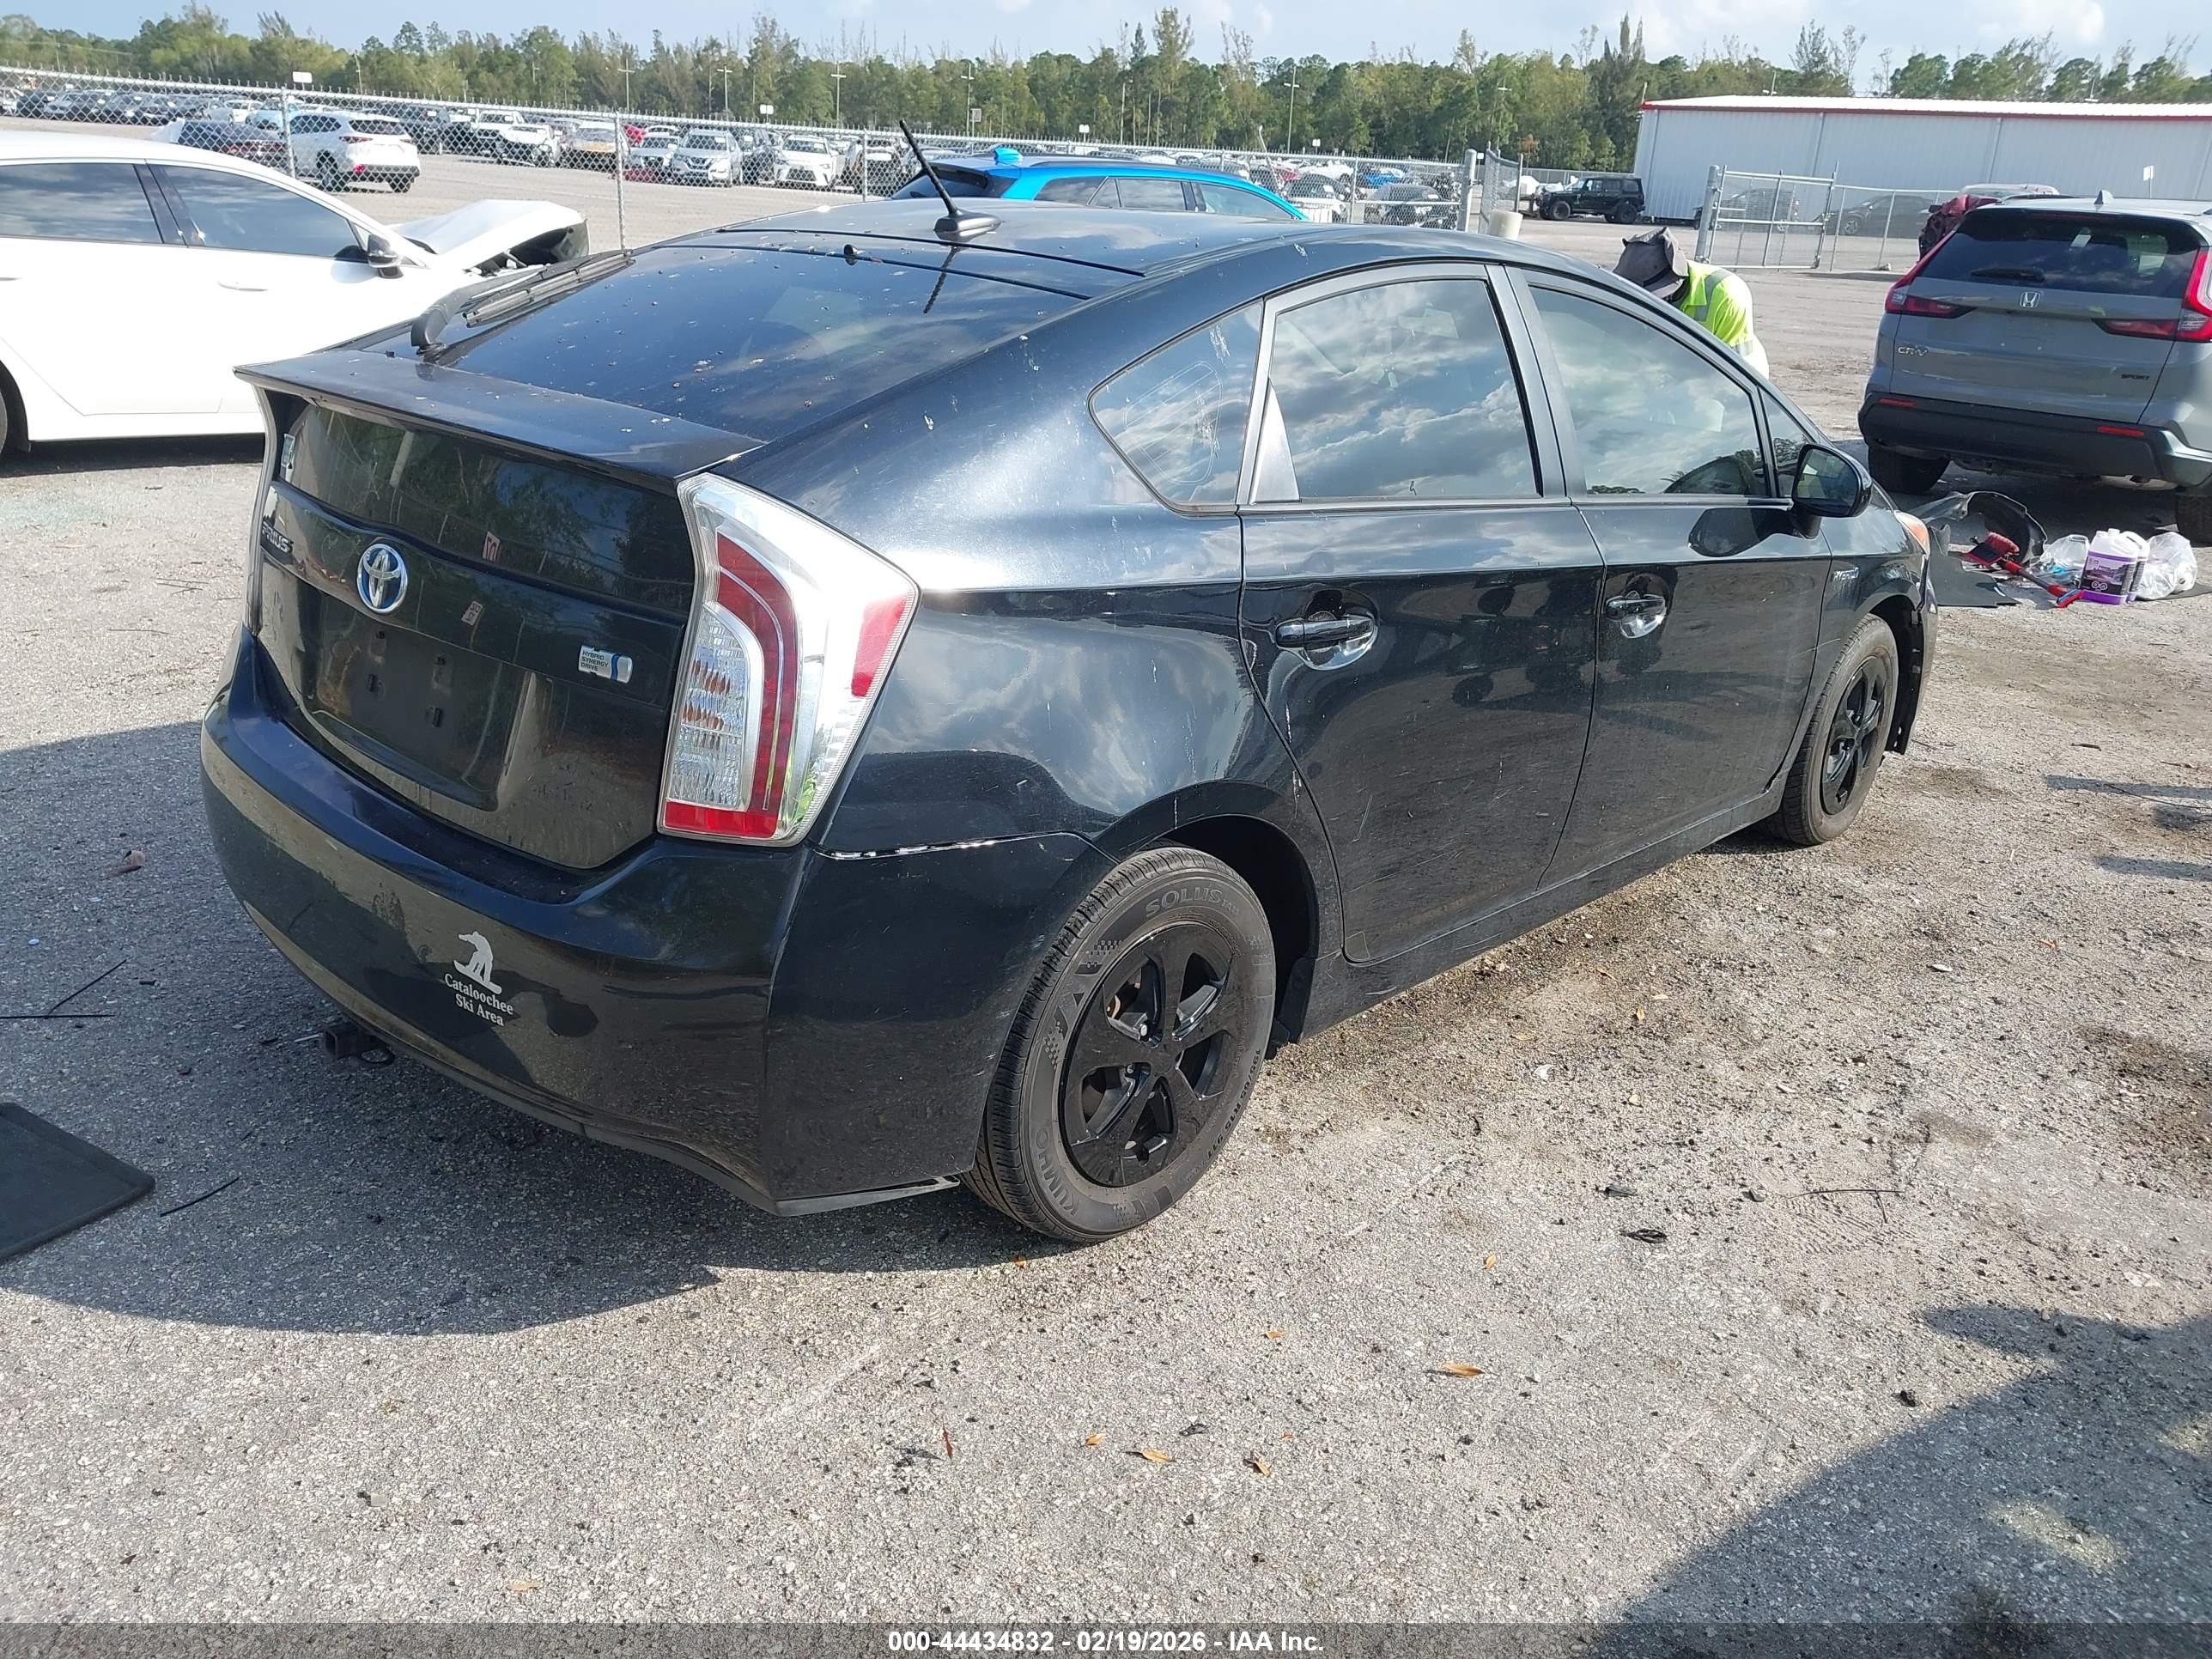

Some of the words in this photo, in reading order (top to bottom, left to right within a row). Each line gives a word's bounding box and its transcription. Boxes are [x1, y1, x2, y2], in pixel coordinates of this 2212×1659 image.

[580, 662, 599, 672] DRIVE
[581, 657, 609, 667] SYNERGY
[582, 651, 605, 660] HYBRID
[1146, 886, 1223, 918] SOLUS
[444, 973, 514, 1015] Cataloochee
[455, 994, 474, 1012] Ski
[477, 1004, 504, 1026] Area
[1036, 1127, 1079, 1217] KUMHO
